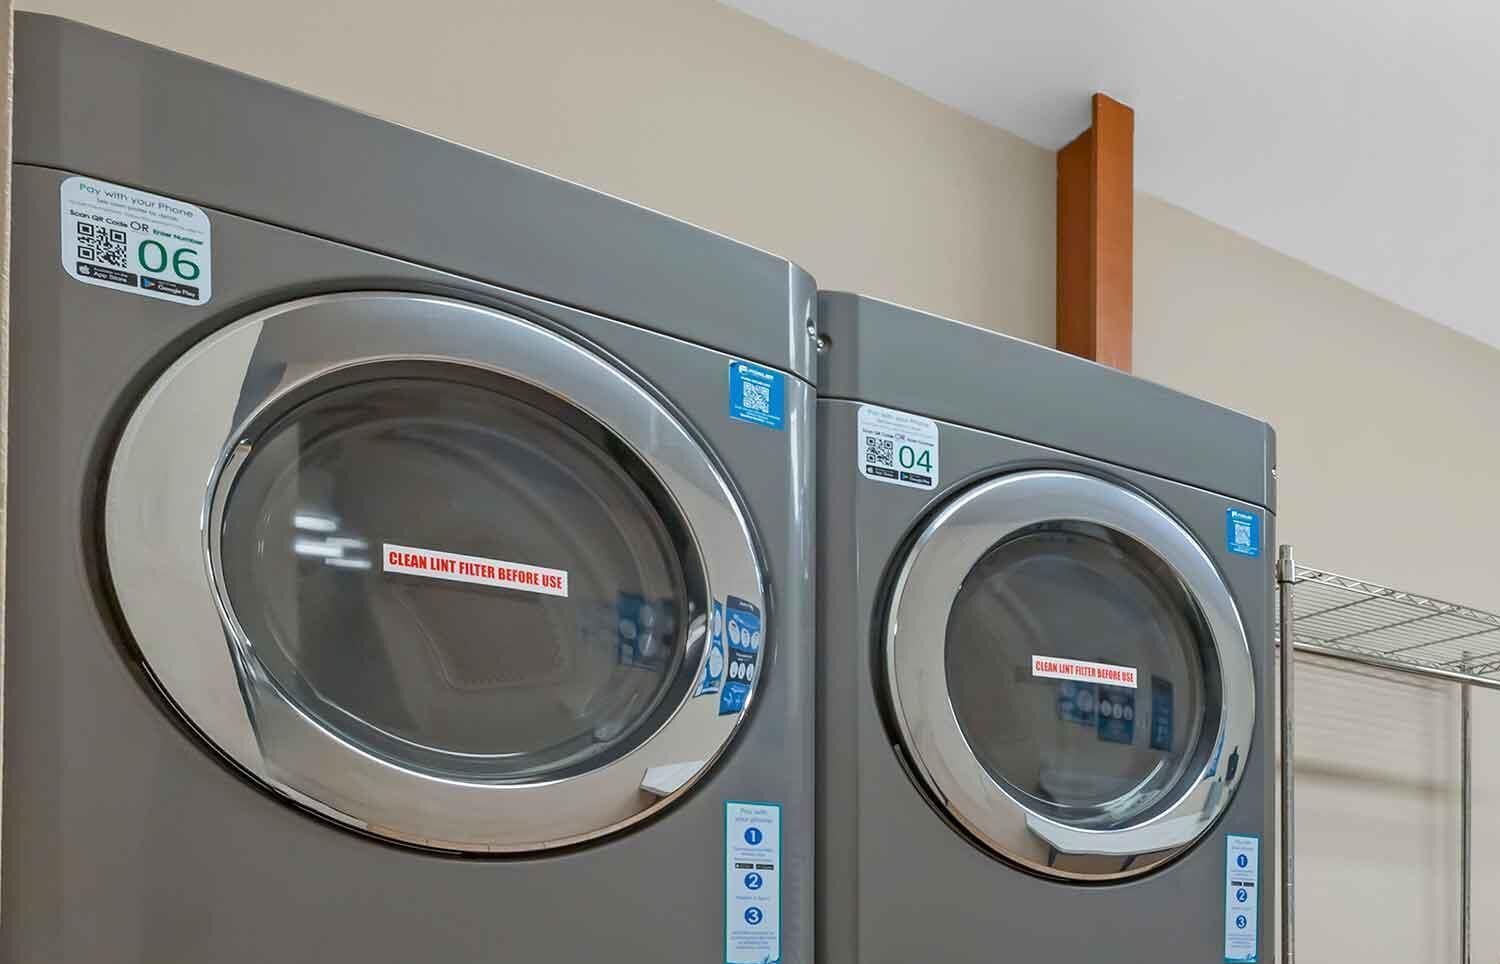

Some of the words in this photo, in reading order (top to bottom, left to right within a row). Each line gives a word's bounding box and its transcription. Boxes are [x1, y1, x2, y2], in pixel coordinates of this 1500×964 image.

[80, 183, 101, 195] Pay
[105, 190, 128, 200] with
[131, 198, 156, 208] your
[158, 203, 194, 217] Phone
[70, 209, 90, 219] Scan
[106, 217, 128, 228] Code
[130, 221, 149, 232] OR
[138, 240, 200, 281] 06
[899, 446, 933, 472] 04
[389, 552, 427, 569] CLEAN
[430, 557, 457, 573] LINT
[459, 562, 495, 579] FILTER
[499, 568, 539, 586] BEFORE
[542, 574, 562, 589] USE
[1036, 661, 1058, 672] CLEAN
[1060, 664, 1074, 674] LINT
[1076, 665, 1096, 677] FILTER
[1098, 668, 1120, 681] BEFORE
[1122, 670, 1134, 682] USE
[748, 874, 758, 888] 2
[748, 910, 758, 922] 3
